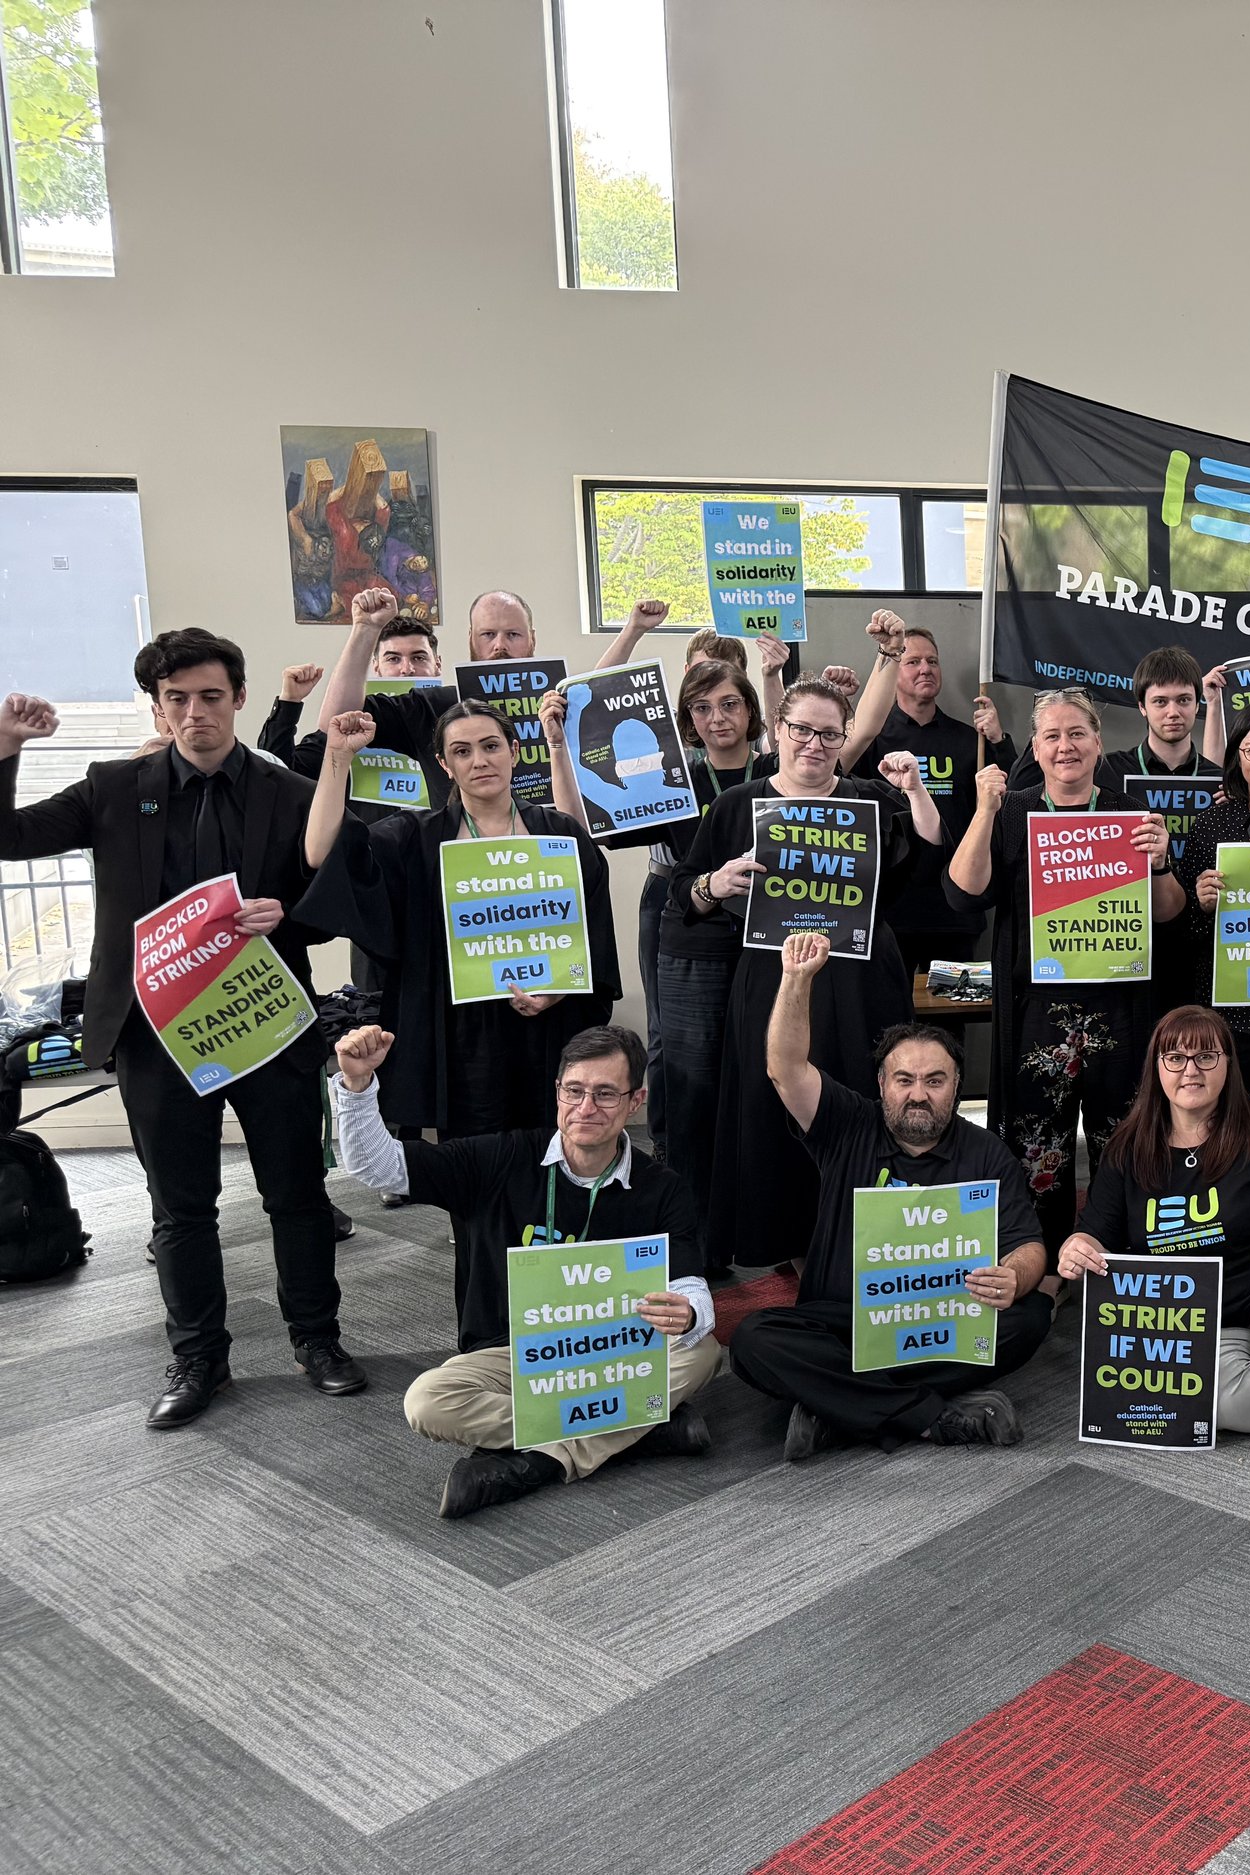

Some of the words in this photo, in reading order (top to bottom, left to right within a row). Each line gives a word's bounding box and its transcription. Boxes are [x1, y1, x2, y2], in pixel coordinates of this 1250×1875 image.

[738, 514, 769, 529] We
[715, 540, 772, 555] stand
[775, 539, 792, 555] in
[716, 564, 796, 581] solidarity
[720, 589, 763, 604] with
[767, 590, 796, 604] the
[1055, 564, 1227, 630] PARADE
[746, 616, 777, 629] AEU
[478, 671, 548, 693] WE’D
[630, 671, 657, 688] WE
[1034, 660, 1133, 691] INDEPENDENT
[604, 688, 660, 711] WON’T
[645, 706, 666, 721] BE
[359, 755, 403, 769] with
[384, 779, 416, 792] AEU
[513, 773, 541, 782] Catholic
[614, 795, 690, 821] SILENCED!
[1146, 790, 1212, 809] WE’D
[780, 806, 856, 826] WE’D
[768, 825, 867, 852] STRIKE
[1037, 824, 1123, 847] BLOCKED
[487, 851, 529, 865] We
[779, 848, 804, 871] IF
[811, 852, 855, 878] WE
[1040, 847, 1093, 866] FROM
[456, 873, 533, 894] stand
[538, 871, 563, 888] in
[1042, 861, 1133, 884] STRIKING.
[765, 876, 863, 906] COULD
[459, 899, 571, 927] solidarity
[1098, 900, 1142, 914] STILL
[140, 898, 209, 954] BLOCKED
[1047, 919, 1142, 933] STANDING
[141, 933, 187, 973] FROM
[464, 935, 523, 957] with
[528, 932, 572, 950] the
[1049, 938, 1097, 952] WITH
[1102, 938, 1142, 951] AEU.
[145, 931, 240, 992] STRIKING.
[500, 963, 544, 982] AEU
[221, 958, 274, 996] STILL
[177, 974, 284, 1040] STANDING
[190, 1020, 251, 1057] WITH
[254, 992, 297, 1028] AEU.
[200, 1069, 220, 1084] IEU
[969, 1188, 990, 1200] IEU
[902, 1206, 948, 1227] We
[1146, 1187, 1219, 1232] IEU
[636, 1246, 658, 1258] IEU
[867, 1238, 949, 1262] stand
[955, 1235, 981, 1256] in
[1150, 1244, 1175, 1254] PROUD
[1199, 1235, 1226, 1246] UNION
[561, 1263, 612, 1286] We
[866, 1268, 973, 1296] solidarit
[1112, 1272, 1196, 1299] WE’D
[524, 1297, 614, 1326] stand
[869, 1303, 931, 1325] with
[937, 1299, 982, 1318] the
[1099, 1302, 1206, 1332] STRIKE
[525, 1326, 655, 1363] solidarity
[903, 1329, 949, 1351] AEU
[1109, 1334, 1136, 1358] IF
[1142, 1337, 1192, 1364] WE
[529, 1370, 597, 1395] with
[603, 1361, 652, 1384] the
[1096, 1365, 1203, 1396] COULD
[568, 1396, 619, 1424] AEU
[1117, 1412, 1157, 1420] education
[1158, 1412, 1177, 1420] staff
[1129, 1404, 1163, 1412] Catholic
[1088, 1425, 1101, 1433] IEU
[1126, 1420, 1148, 1428] stand
[1150, 1420, 1167, 1428] with
